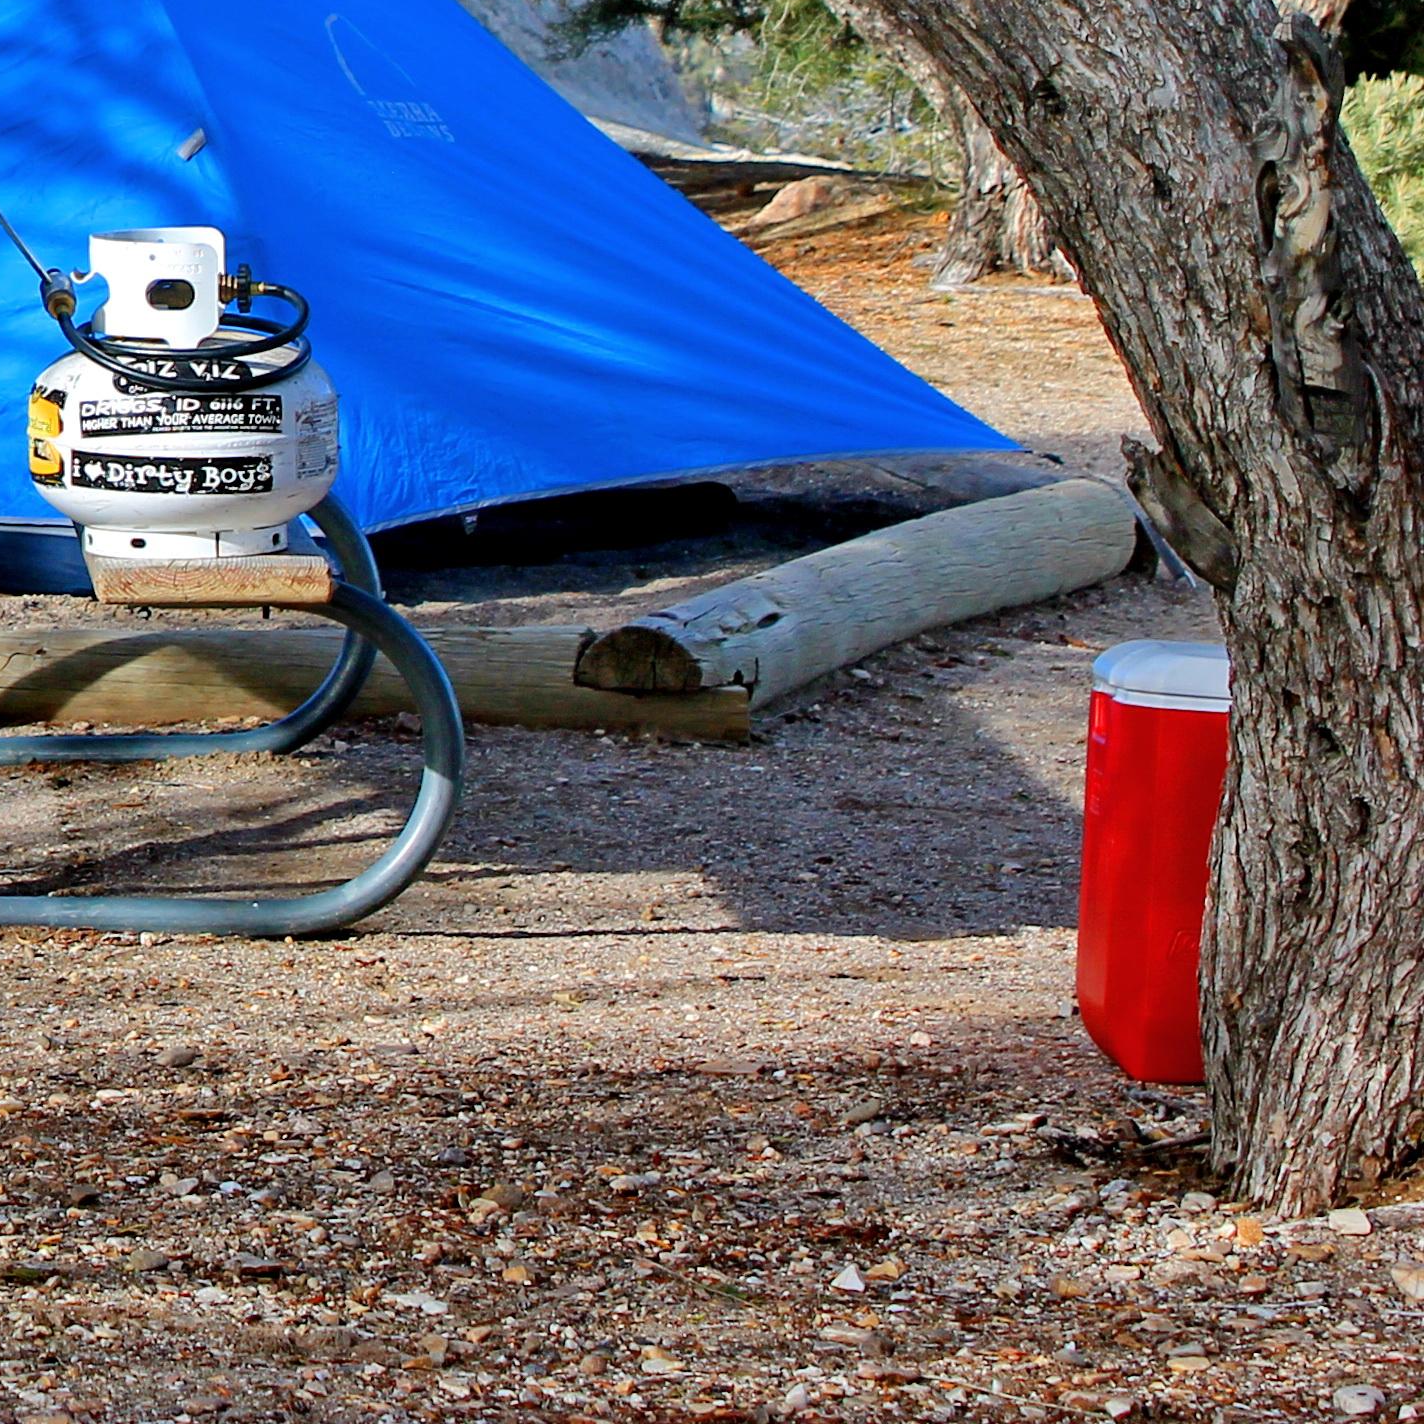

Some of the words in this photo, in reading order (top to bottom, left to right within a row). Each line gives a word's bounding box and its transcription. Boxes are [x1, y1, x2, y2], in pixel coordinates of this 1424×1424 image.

[83, 416, 117, 431] HIGHER
[121, 414, 152, 426] THAN
[156, 412, 188, 426] YOUR
[192, 413, 244, 425] AVERAGE
[108, 461, 193, 493] Dirty
[202, 462, 271, 490] Boys
